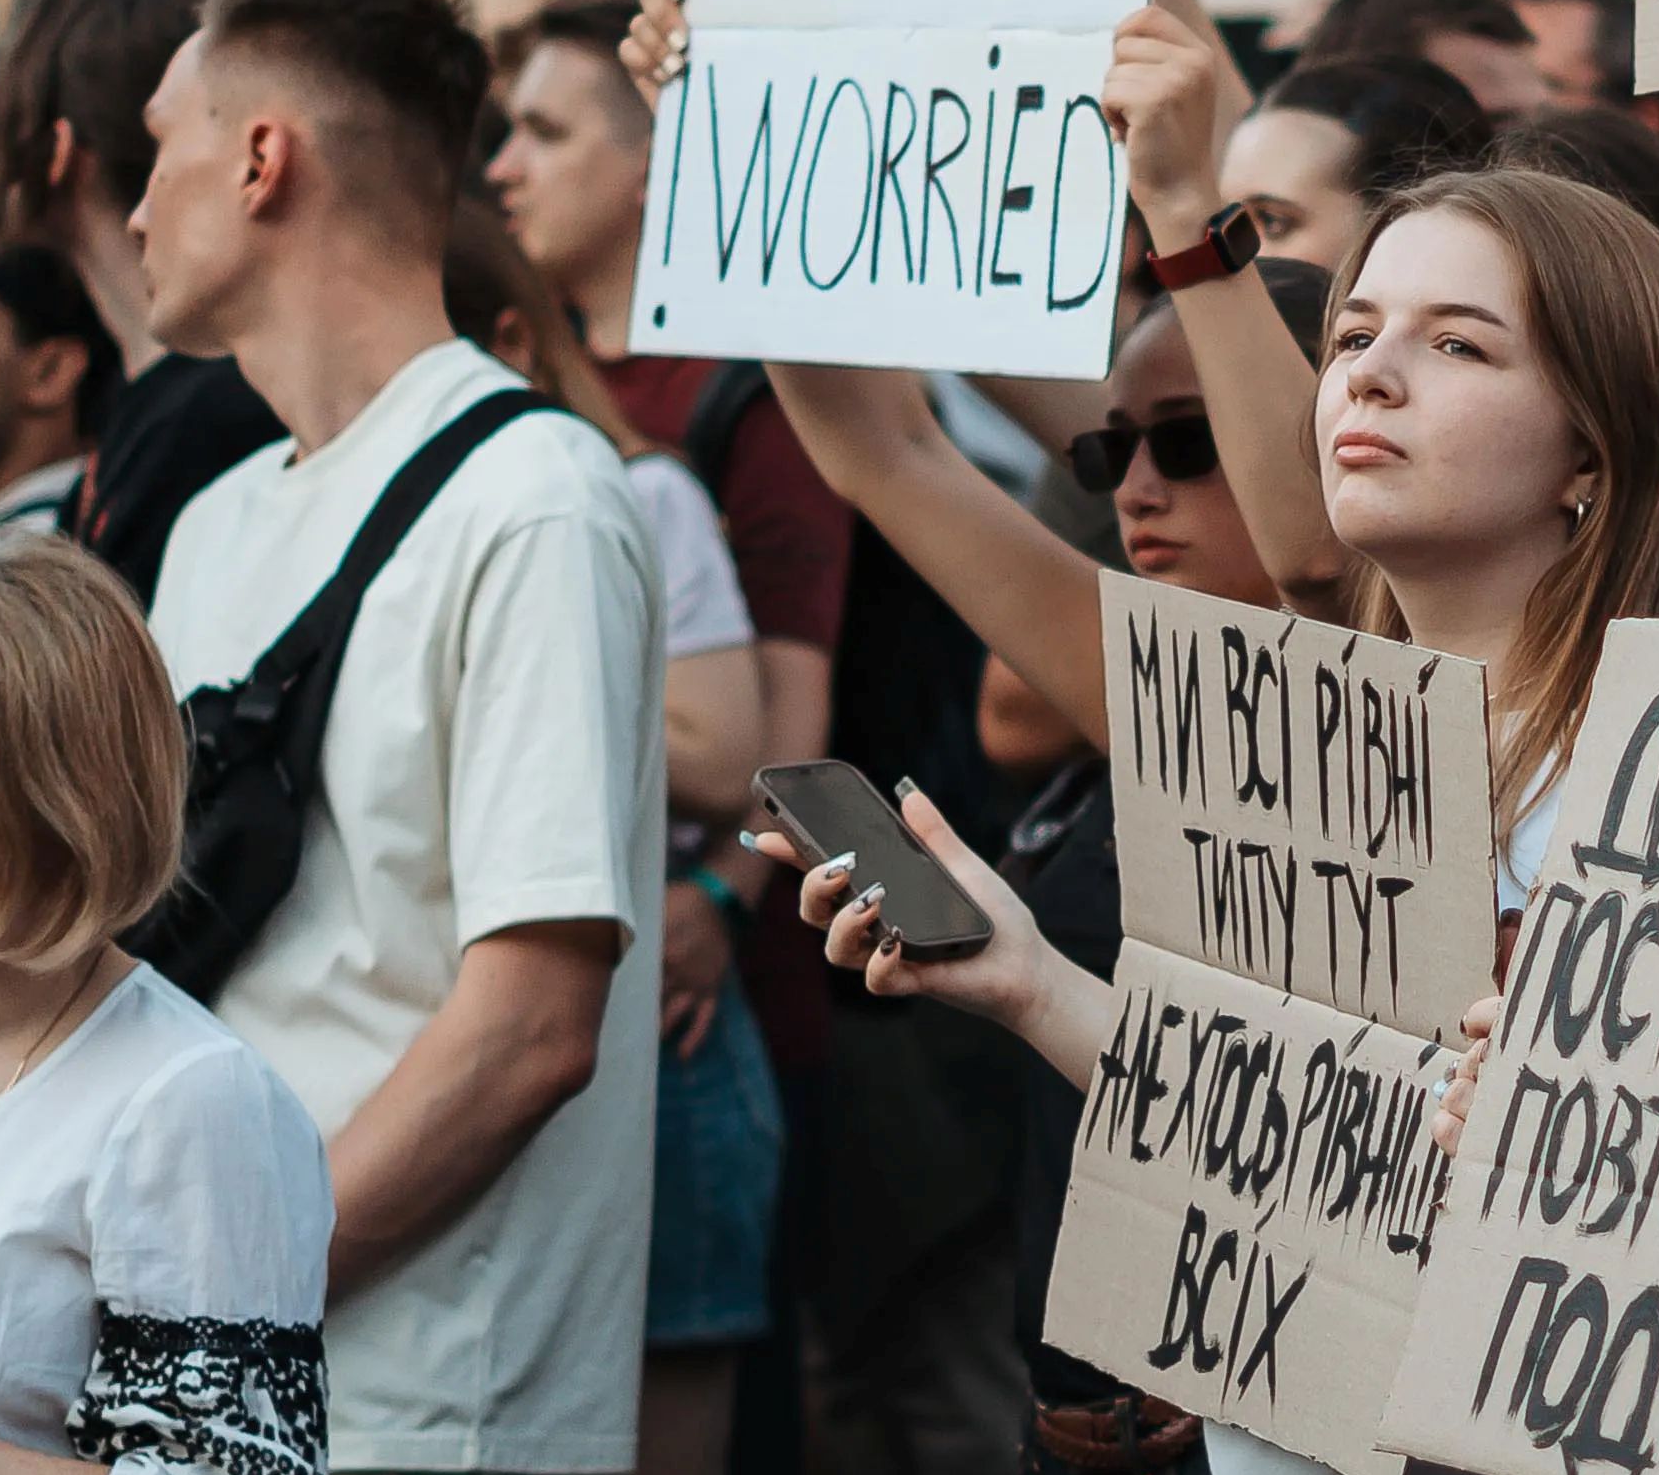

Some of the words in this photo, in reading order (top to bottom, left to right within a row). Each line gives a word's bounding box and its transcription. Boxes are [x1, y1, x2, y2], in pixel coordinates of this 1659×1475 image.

[1128, 605, 1209, 812] МИ
[1221, 607, 1298, 818] ВСІ
[1311, 637, 1444, 866] РІВНІ
[1180, 824, 1302, 995] ТИПУ
[1310, 856, 1419, 1020] ТУТ
[1159, 1007, 1290, 1211] ХТОСЬ
[1145, 1195, 1314, 1408] ВСІХ
